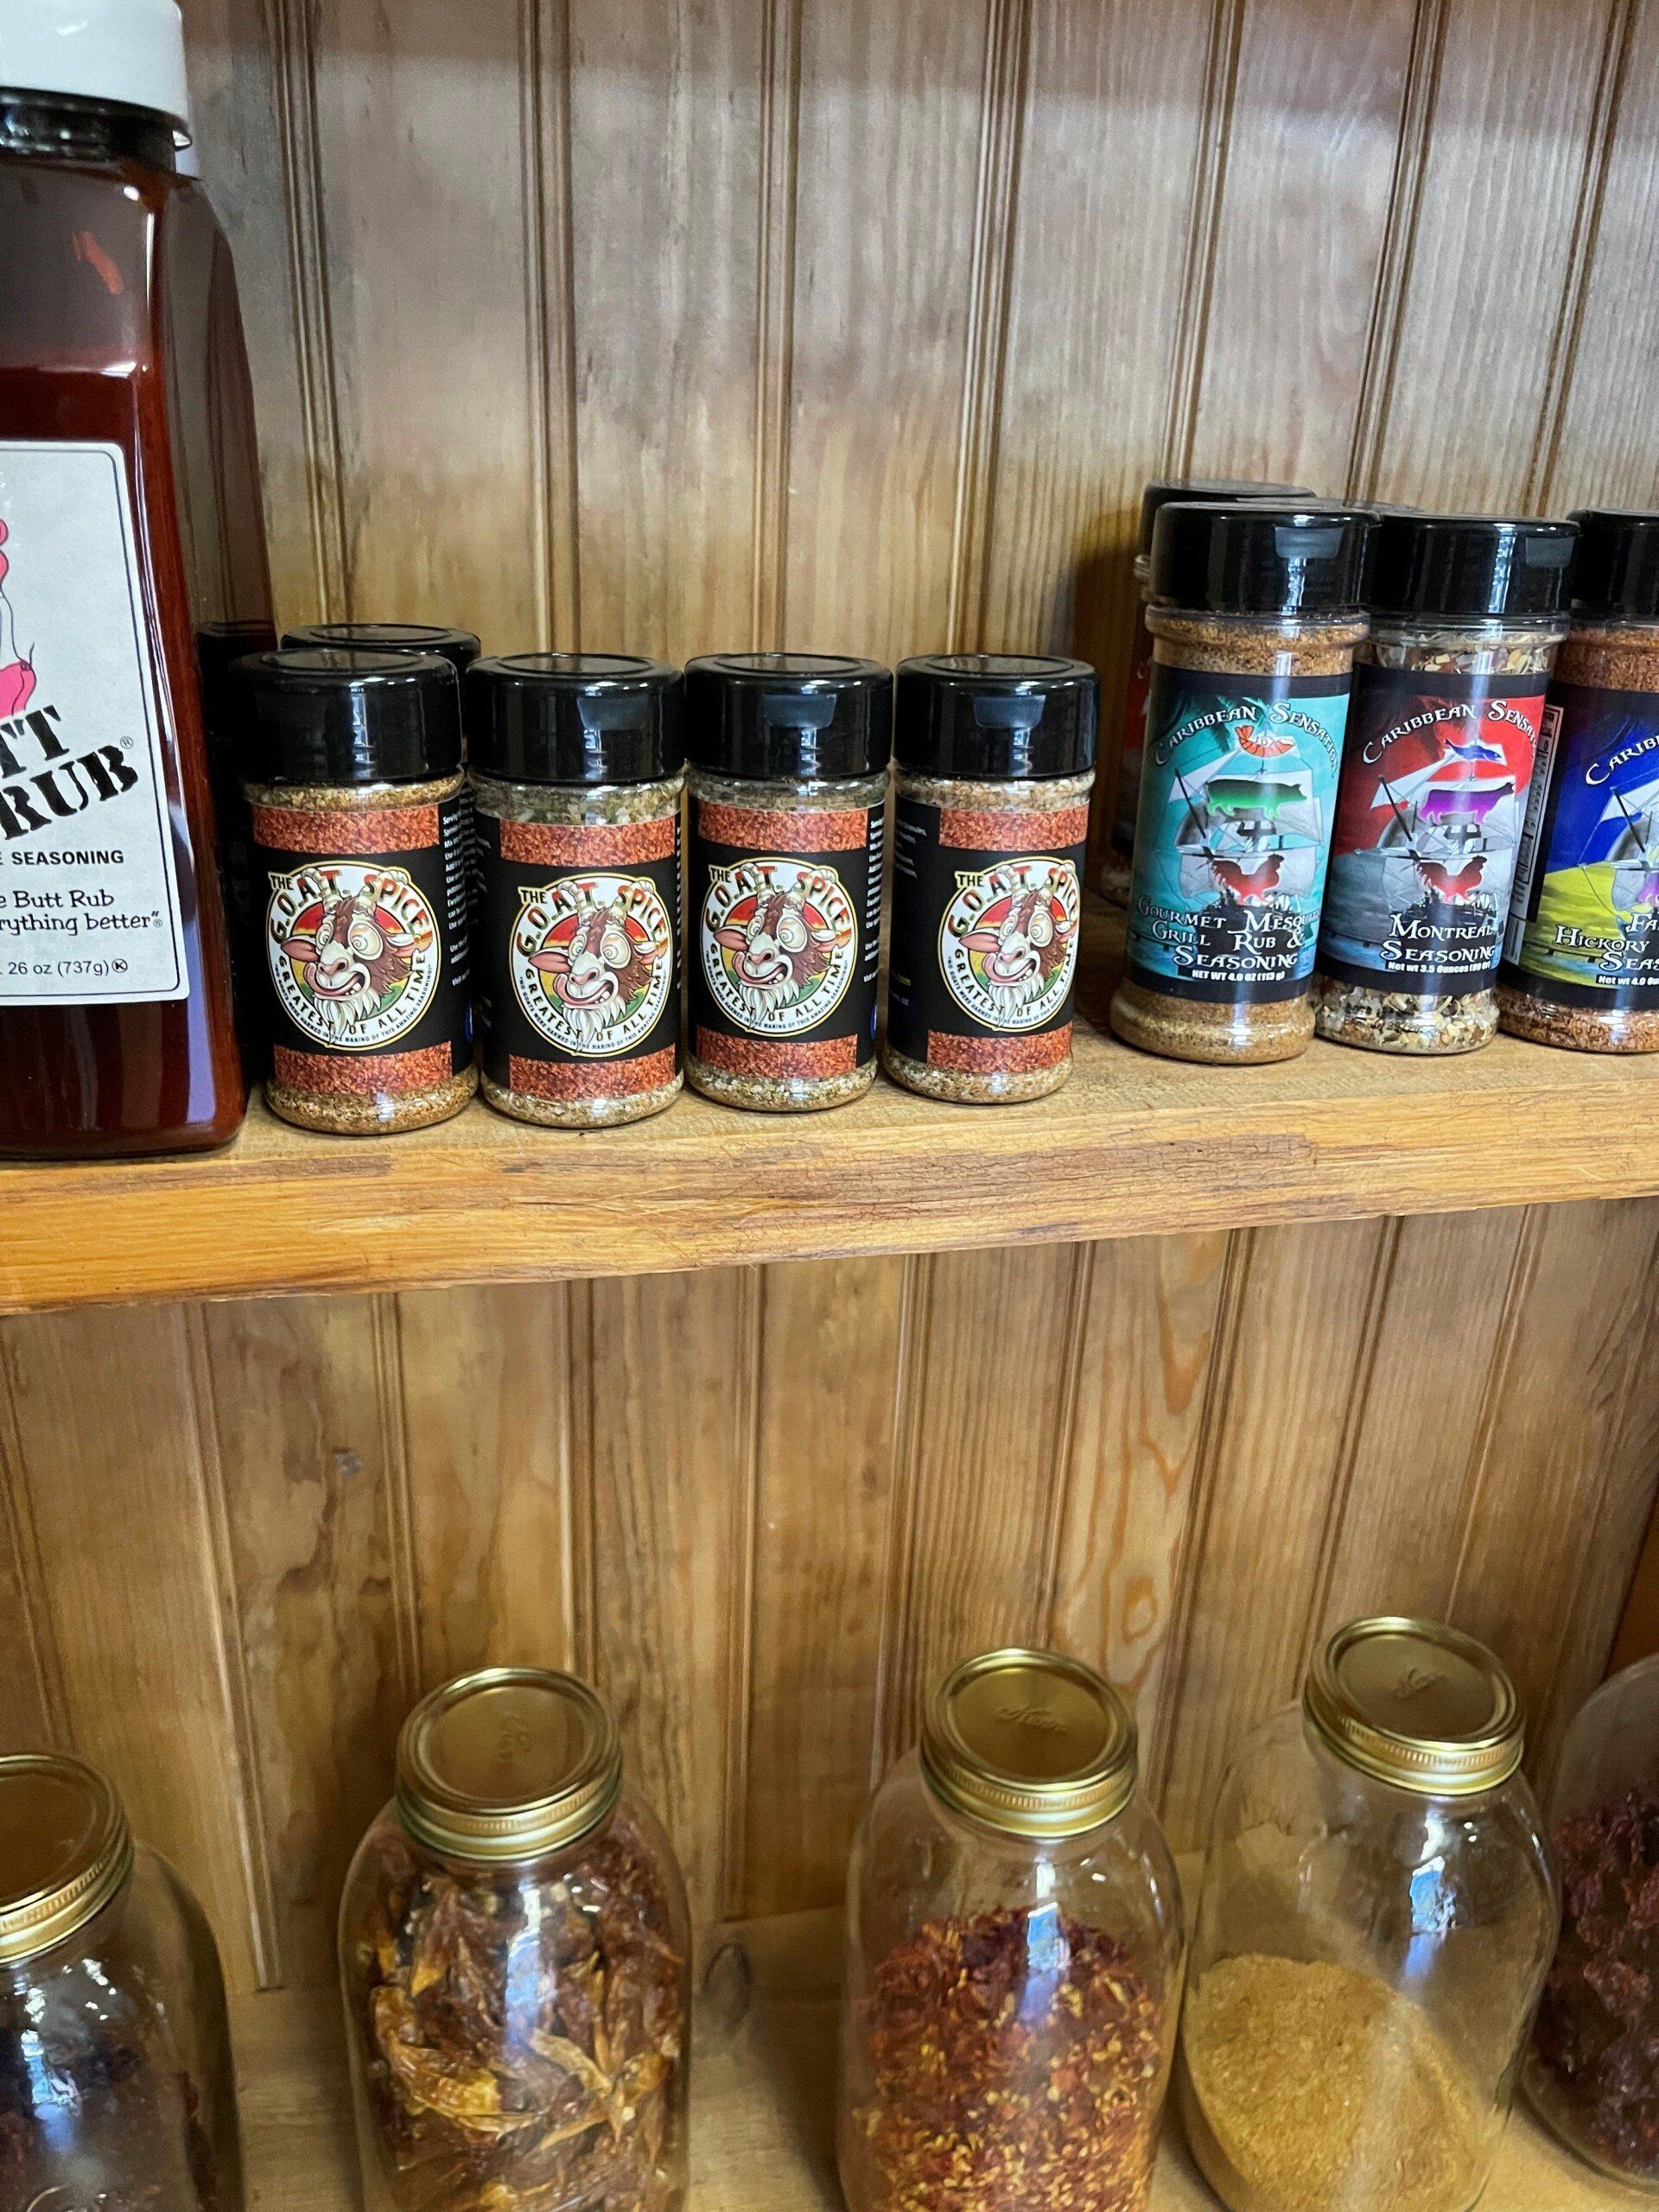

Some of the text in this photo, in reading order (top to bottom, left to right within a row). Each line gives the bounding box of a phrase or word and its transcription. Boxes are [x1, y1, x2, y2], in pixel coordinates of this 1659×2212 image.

[1155, 705, 1258, 766] CARIBBEAN
[1363, 700, 1536, 764] CARIBBEAN SENSATI
[1585, 734, 1659, 785] CARIB
[11, 849, 124, 865] SEASONING
[270, 875, 292, 890] THE
[710, 868, 732, 883] THE
[957, 874, 983, 887] THE
[12, 890, 64, 908] Butt
[68, 888, 115, 908] Rub
[521, 889, 547, 904] THE
[1137, 895, 1226, 930] GOURMET
[1152, 919, 1305, 956] GRILL RUB &
[1388, 912, 1493, 942] MONTREAL
[1555, 925, 1650, 953] HICKORY
[1173, 944, 1299, 970] SEASONING
[1380, 940, 1496, 963] SEASONING
[8, 961, 29, 975] 26
[33, 964, 53, 975] oz
[57, 959, 110, 977] (737g)
[1192, 969, 1210, 979] NET
[1211, 970, 1227, 981] WT
[1228, 972, 1244, 982] 4.0
[1388, 961, 1405, 971] Net
[1420, 964, 1435, 973] 3.5
[1436, 964, 1469, 974] Ounces
[1598, 975, 1616, 985] Net
[1630, 976, 1646, 986] 4.0
[279, 955, 334, 1032] GREATEST
[349, 1024, 367, 1035] OF
[378, 1007, 407, 1028] ALL
[404, 954, 426, 1001] TIME
[710, 943, 843, 1021] GREATEST OF ALL TIME
[955, 948, 1005, 1014] GREATEST
[1016, 1006, 1032, 1017] OF
[1039, 989, 1059, 1009] ALL
[525, 961, 663, 1042] GREATEST OF ALL TIME
